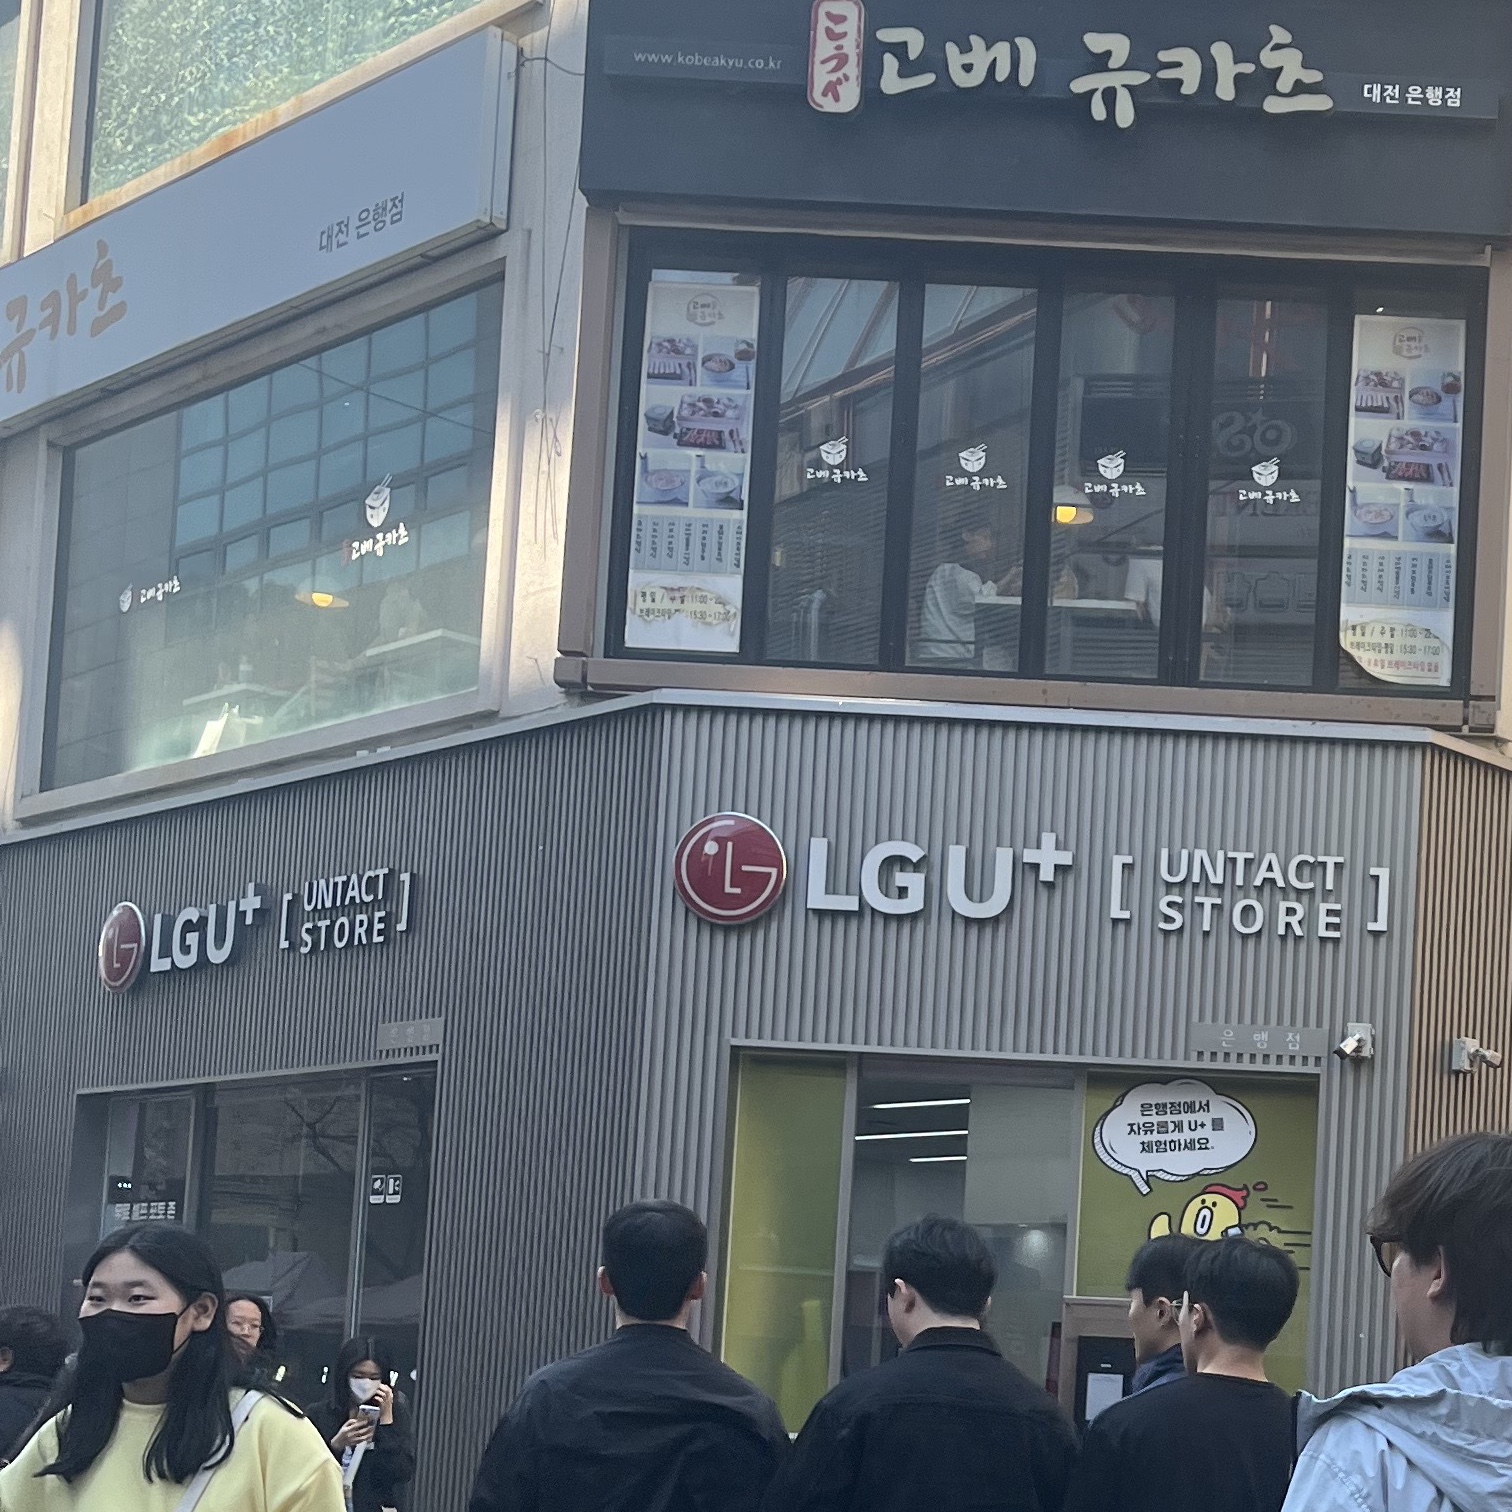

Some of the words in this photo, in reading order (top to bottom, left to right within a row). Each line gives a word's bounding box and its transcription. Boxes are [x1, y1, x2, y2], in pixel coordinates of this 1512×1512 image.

[633, 49, 783, 72] www.kobeakyu.co.kr
[875, 26, 1038, 95] 고베
[1068, 23, 1335, 129] 규카츠
[1362, 83, 1401, 105] 대전
[1405, 86, 1463, 108] 은행점
[318, 215, 351, 254] 대전
[355, 192, 405, 239] 은행점
[303, 867, 390, 912] UNTACT
[1159, 847, 1345, 891] UNTACT
[299, 910, 387, 955] STORE
[1157, 894, 1343, 939] STORE
[1139, 1099, 1211, 1117] 은행점에서
[1187, 1119, 1207, 1133] U+
[1139, 1137, 1215, 1154] 체험하세요.
